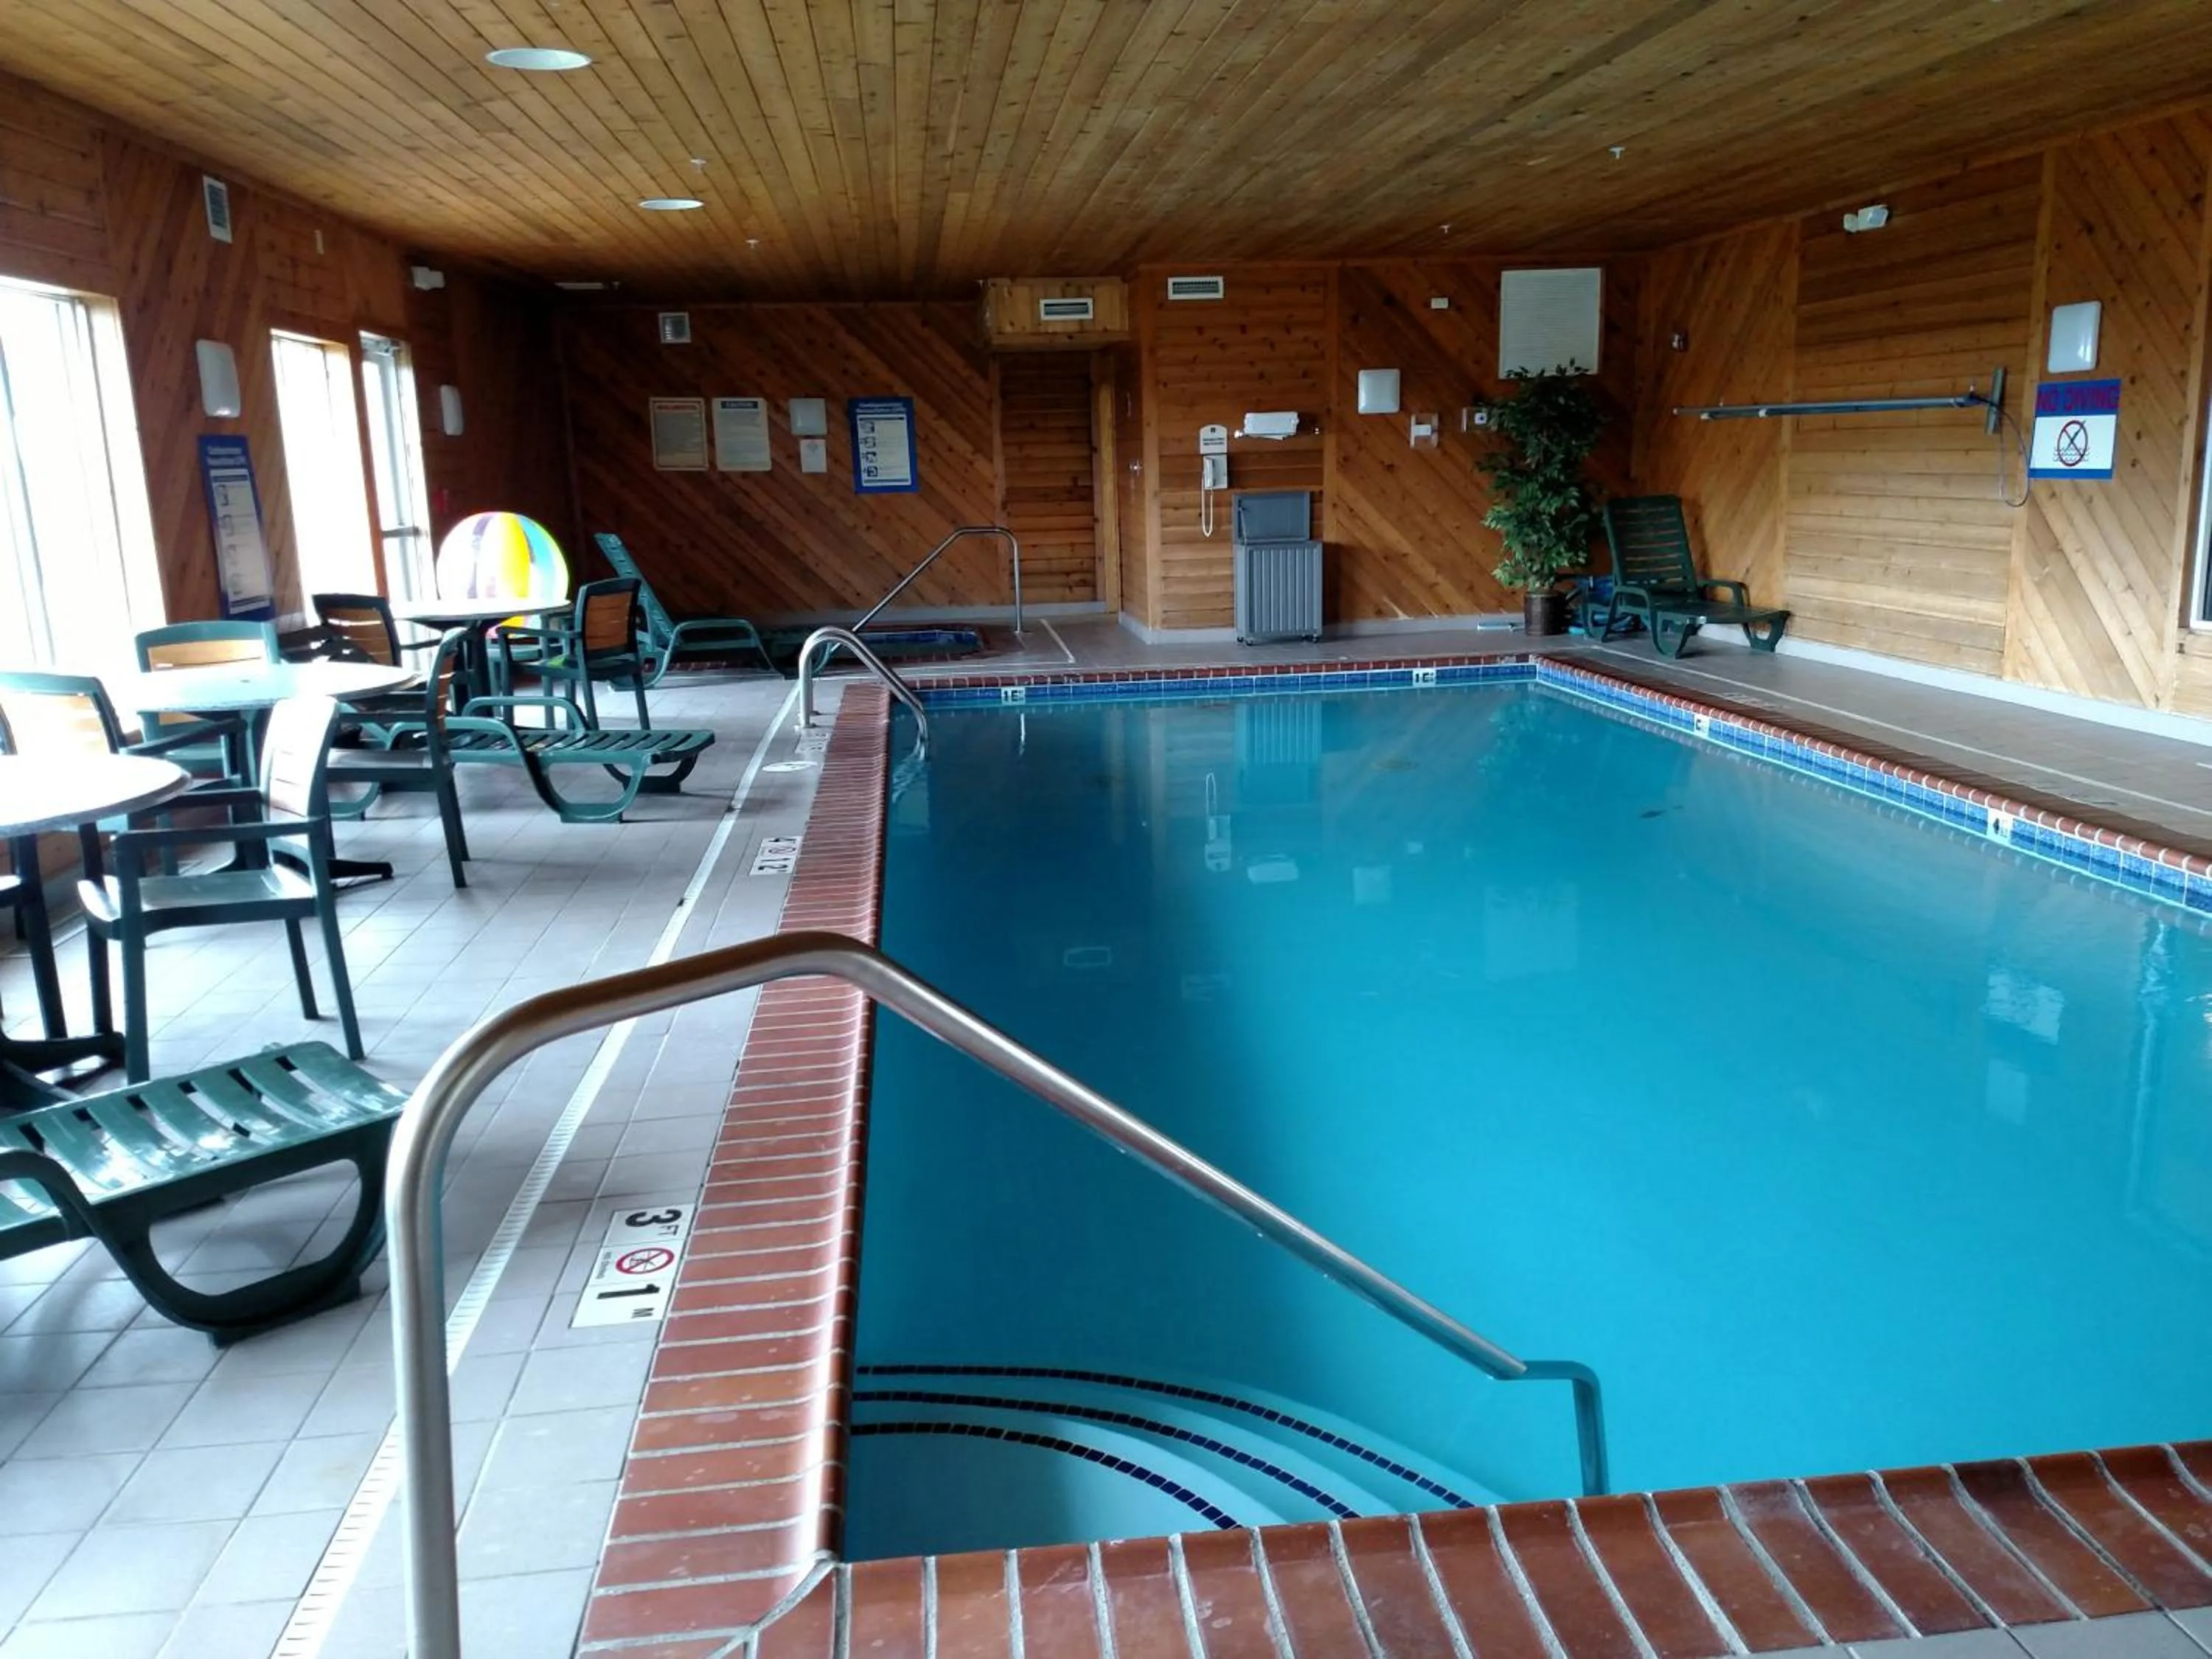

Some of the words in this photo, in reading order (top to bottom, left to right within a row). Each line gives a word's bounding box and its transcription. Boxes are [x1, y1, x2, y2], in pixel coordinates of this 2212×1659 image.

[625, 1209, 682, 1227] 3
[658, 1224, 679, 1237] FT
[597, 1284, 661, 1299] 1
[632, 1307, 654, 1318] M
